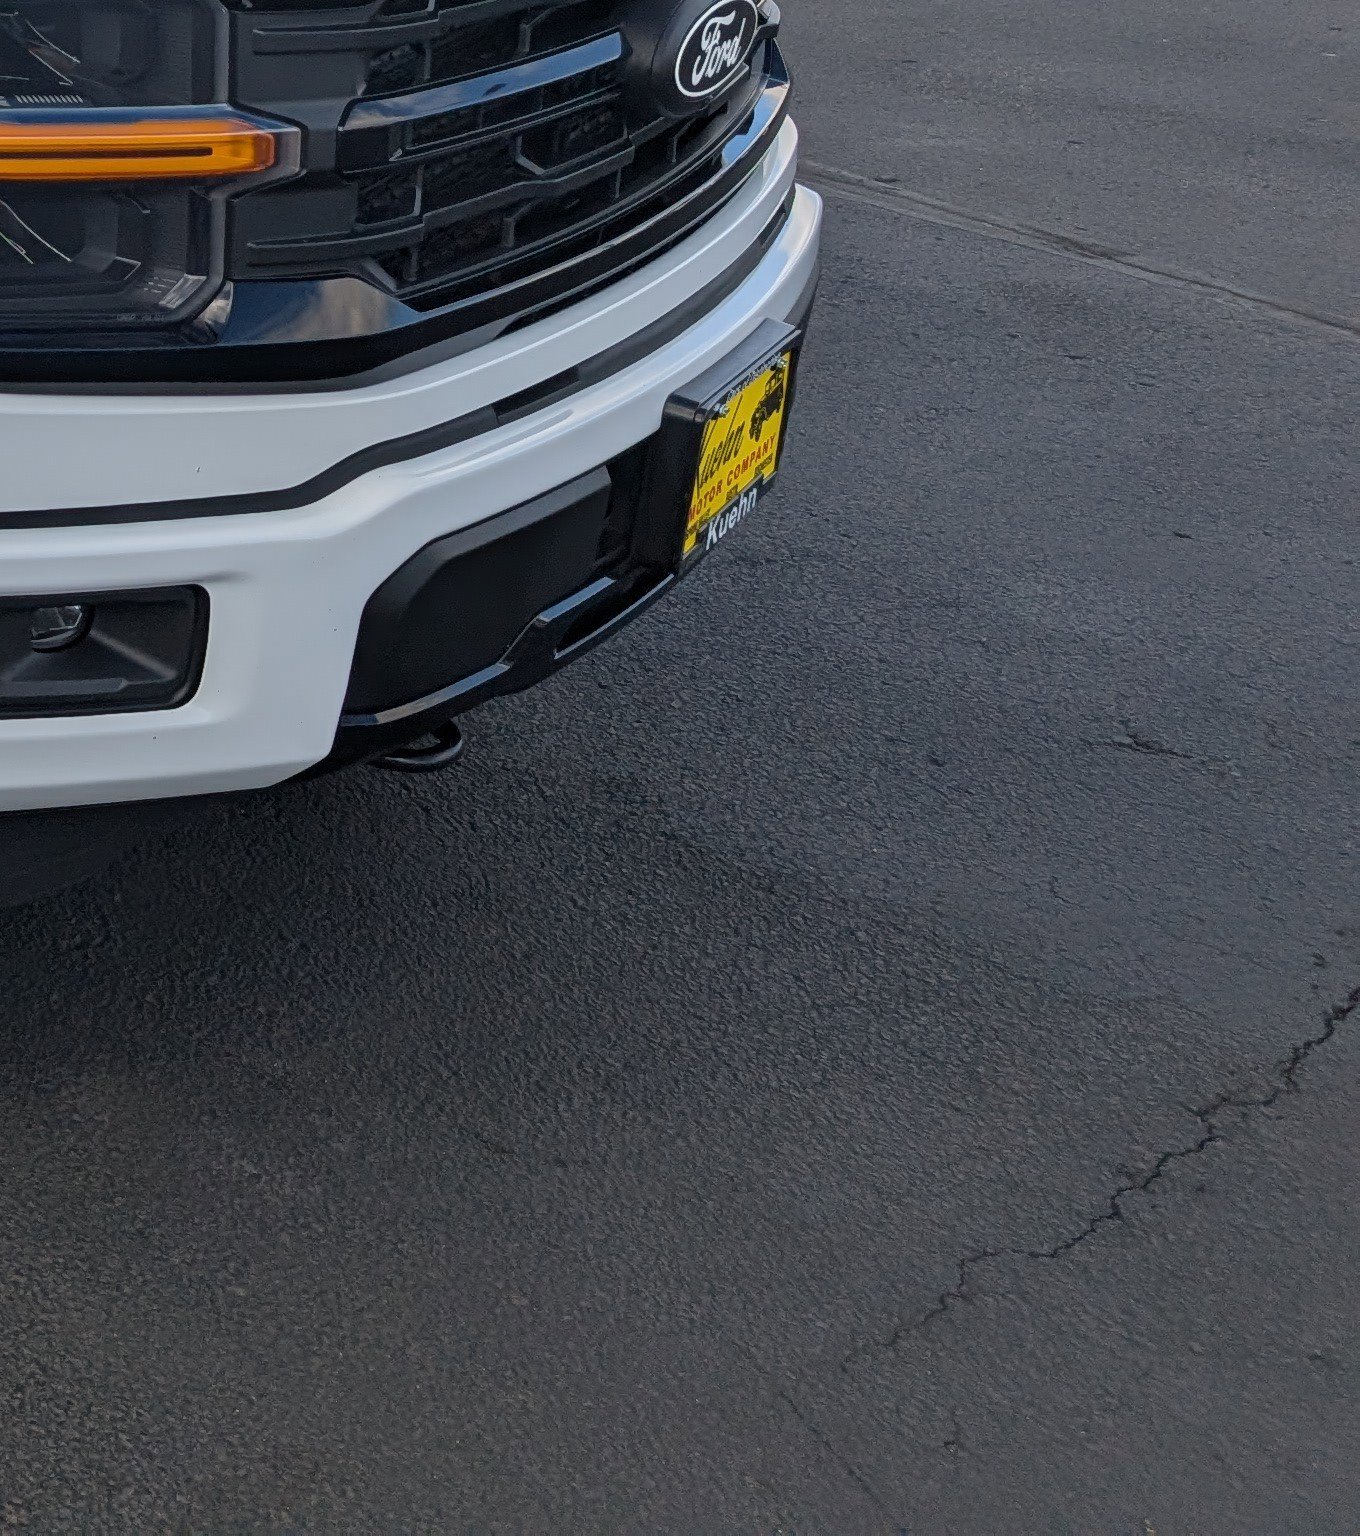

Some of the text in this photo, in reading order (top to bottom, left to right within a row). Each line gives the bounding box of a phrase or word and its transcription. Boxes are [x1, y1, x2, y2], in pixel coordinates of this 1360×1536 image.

[691, 10, 746, 86] Ford
[689, 479, 723, 521] MOTOR
[726, 432, 776, 486] COMPANY
[705, 486, 757, 550] Kuehn
